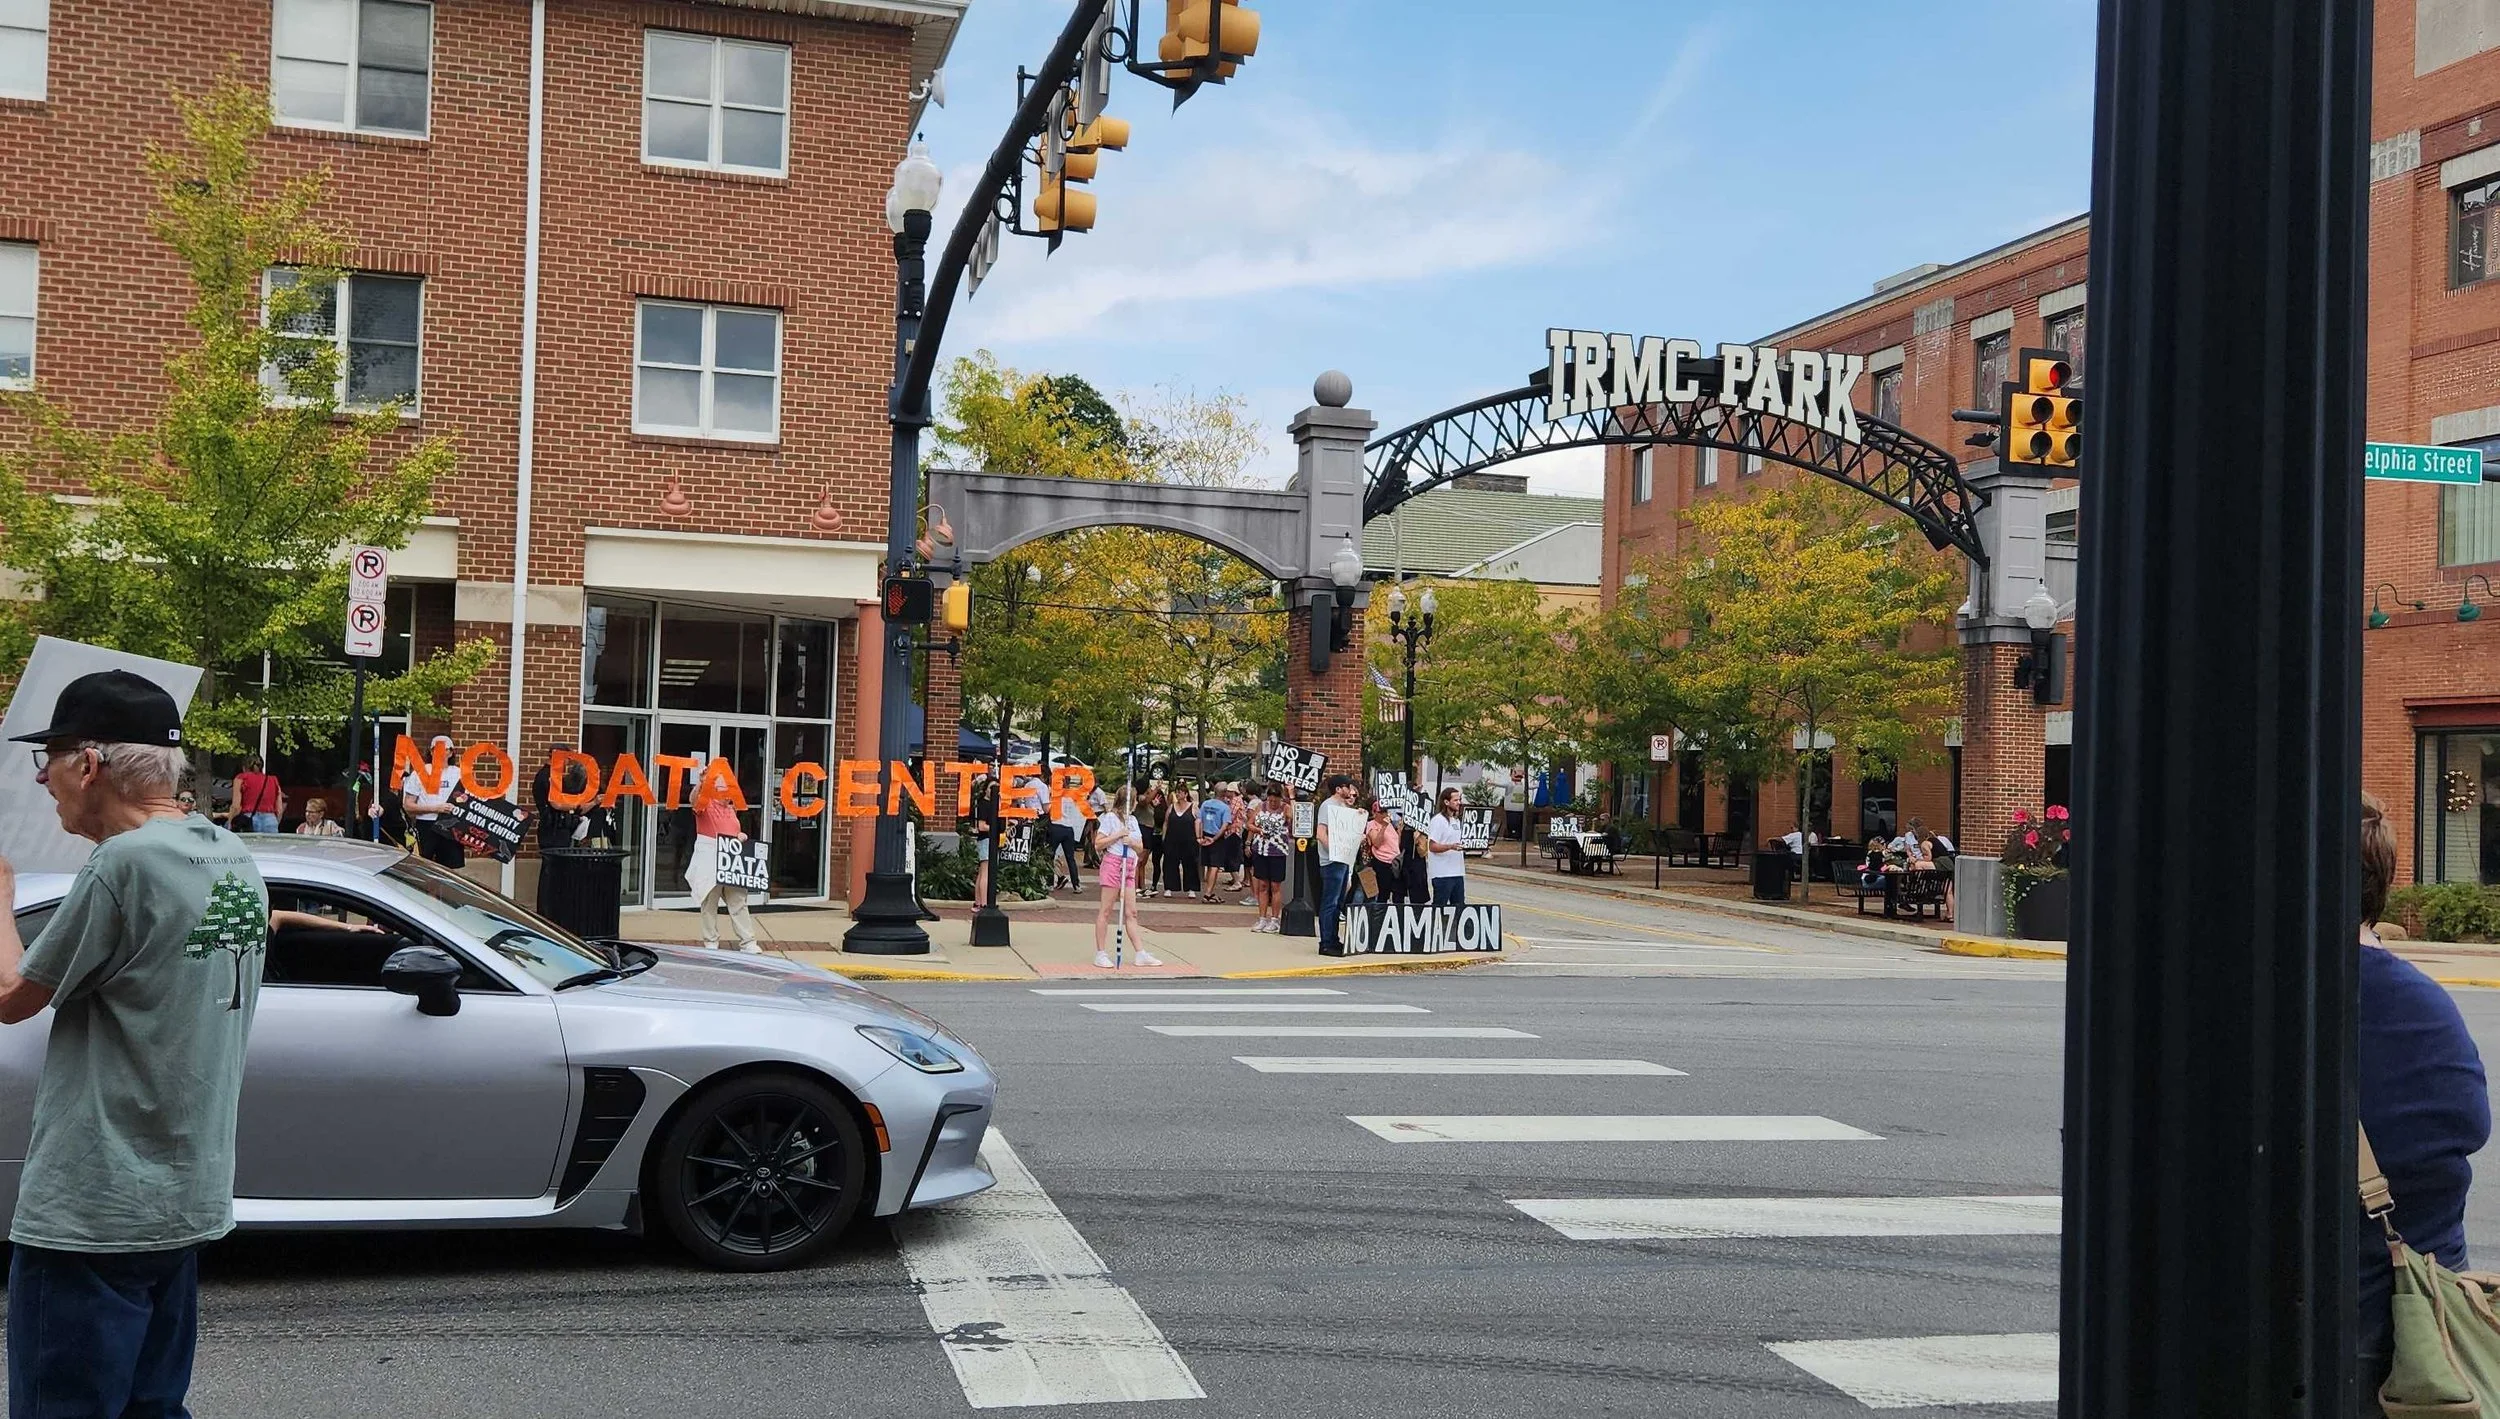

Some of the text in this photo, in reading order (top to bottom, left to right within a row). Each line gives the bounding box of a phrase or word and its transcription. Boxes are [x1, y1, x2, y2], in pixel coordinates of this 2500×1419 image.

[1546, 328, 1864, 446] IRMC PARK
[2365, 448, 2472, 474] elphia Street
[1275, 744, 1299, 761] NO
[390, 734, 1097, 820] NO DATA CENTER
[1270, 755, 1319, 783] DATA
[1379, 773, 1392, 785] NO
[1267, 769, 1317, 791] CENTERS
[1379, 784, 1406, 798] DATA
[1406, 789, 1419, 805] NO
[1380, 797, 1405, 807] CENTER
[452, 806, 521, 844] OT DATA CENTERS
[470, 800, 520, 830] COMMUNITY
[1405, 801, 1431, 829] DATA
[1465, 810, 1478, 824] NO
[1462, 823, 1489, 839] DATA
[1551, 823, 1579, 832] DATA
[718, 836, 743, 855] NO
[718, 851, 769, 878] DATA
[1000, 851, 1028, 862] CENTERS
[717, 870, 769, 890] CENTERS
[1344, 905, 1500, 954] NO AMAZON
